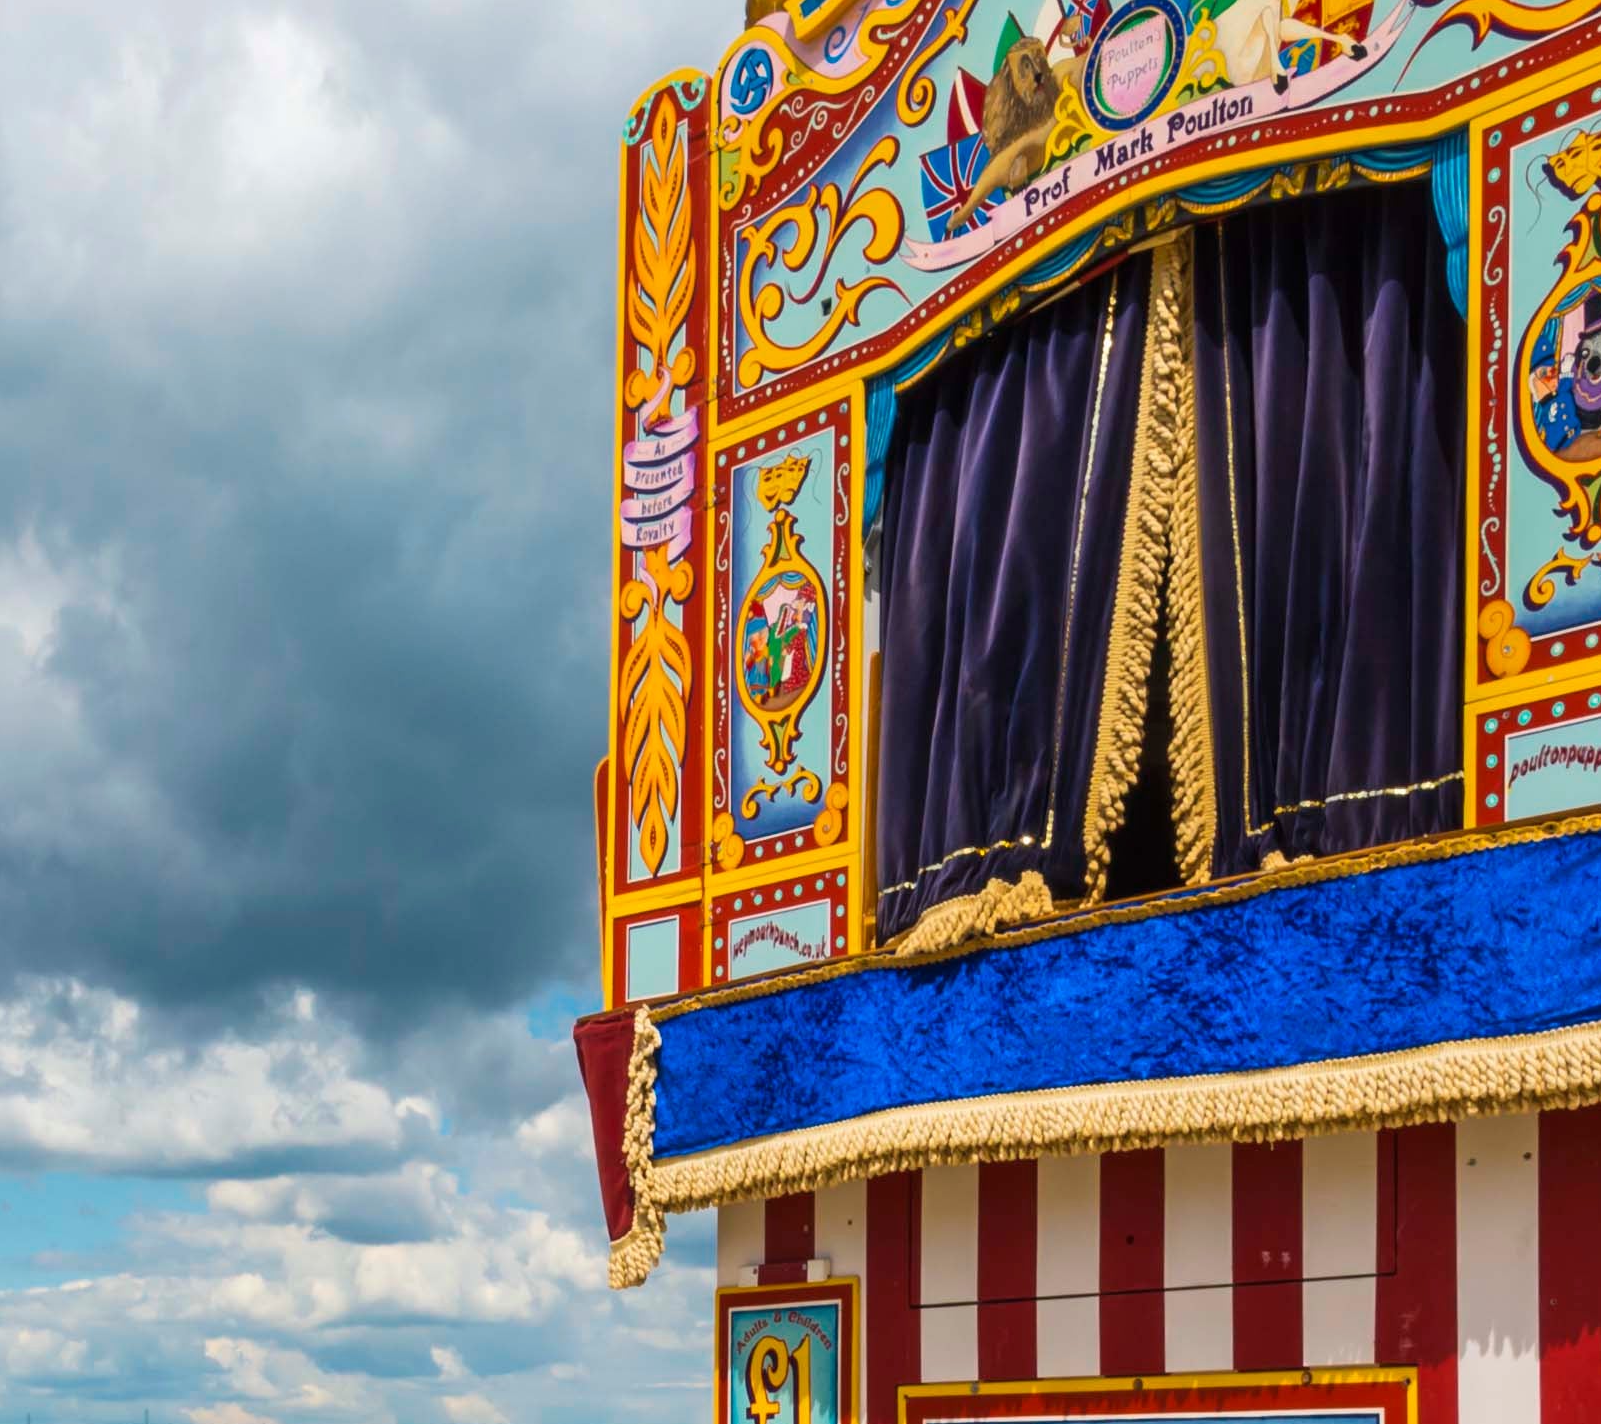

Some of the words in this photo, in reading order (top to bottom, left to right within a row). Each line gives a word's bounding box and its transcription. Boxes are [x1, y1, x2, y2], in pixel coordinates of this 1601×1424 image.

[1024, 166, 1072, 217] Prof
[1094, 127, 1154, 177] Mark
[1166, 95, 1254, 144] Poulton
[636, 519, 675, 542] Royalty
[737, 1318, 769, 1355] Adults
[788, 1311, 832, 1351] Children
